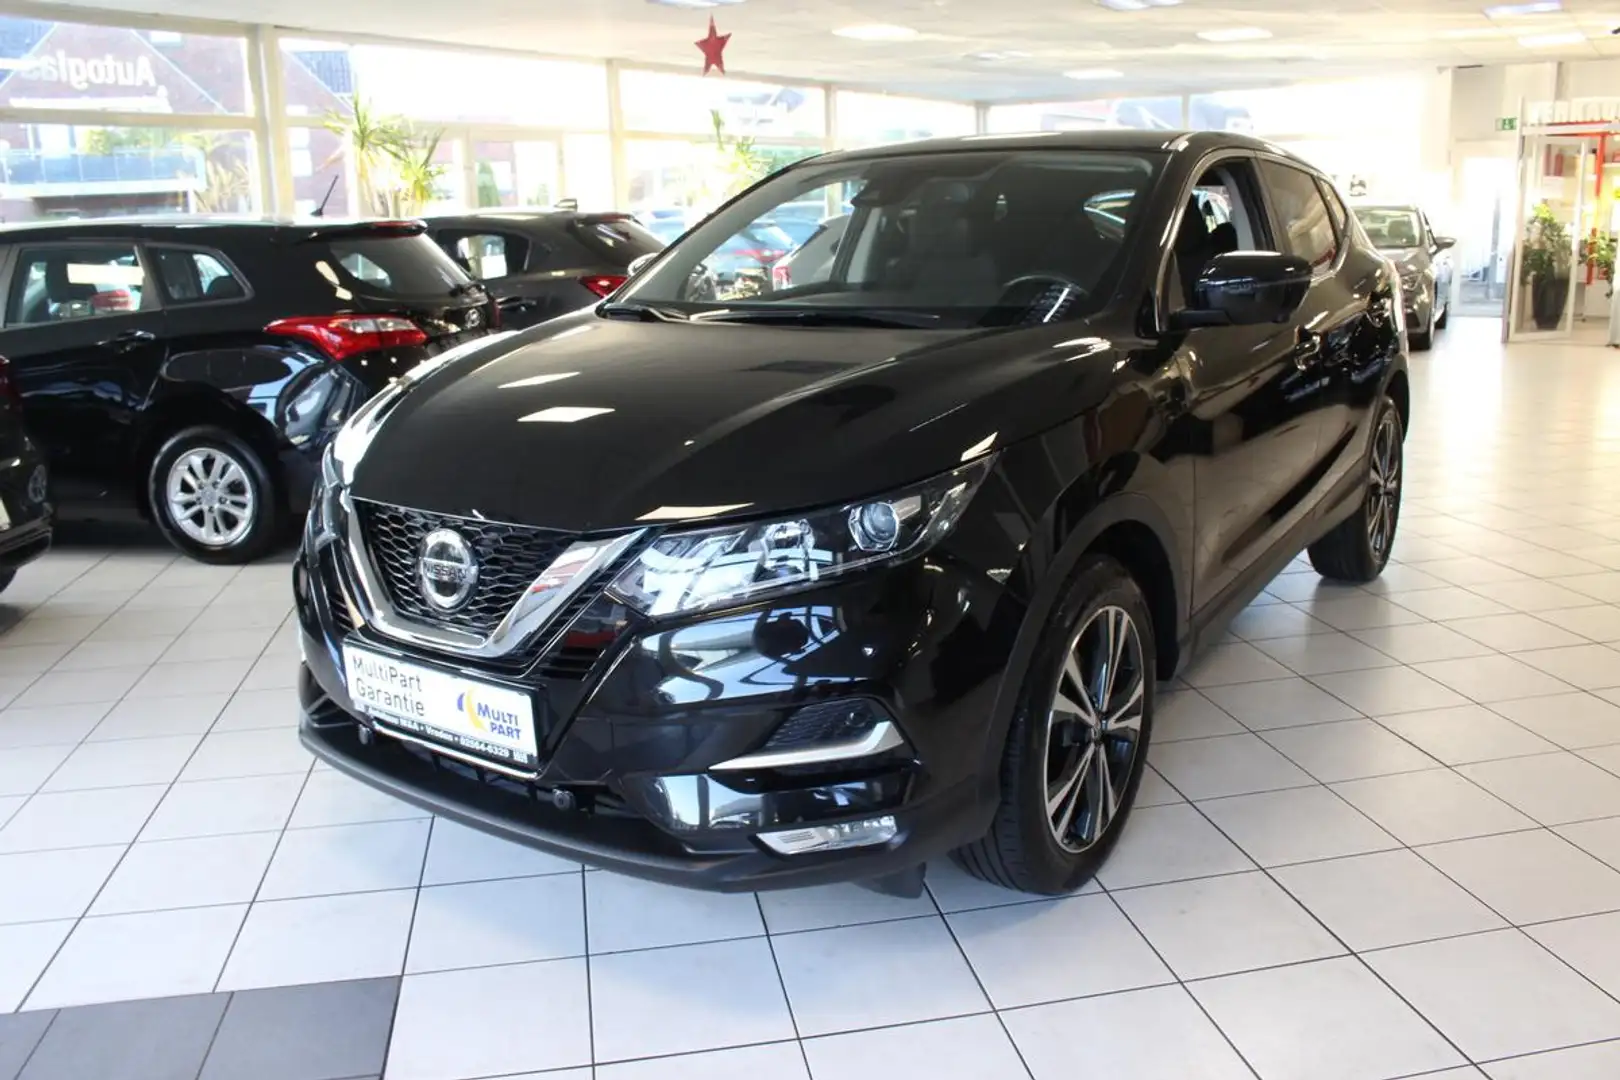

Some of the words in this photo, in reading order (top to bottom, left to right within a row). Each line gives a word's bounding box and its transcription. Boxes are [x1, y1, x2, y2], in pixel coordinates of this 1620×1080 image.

[352, 655, 422, 692] MultiPart
[355, 677, 425, 717] Garantie
[489, 722, 521, 741] PART
